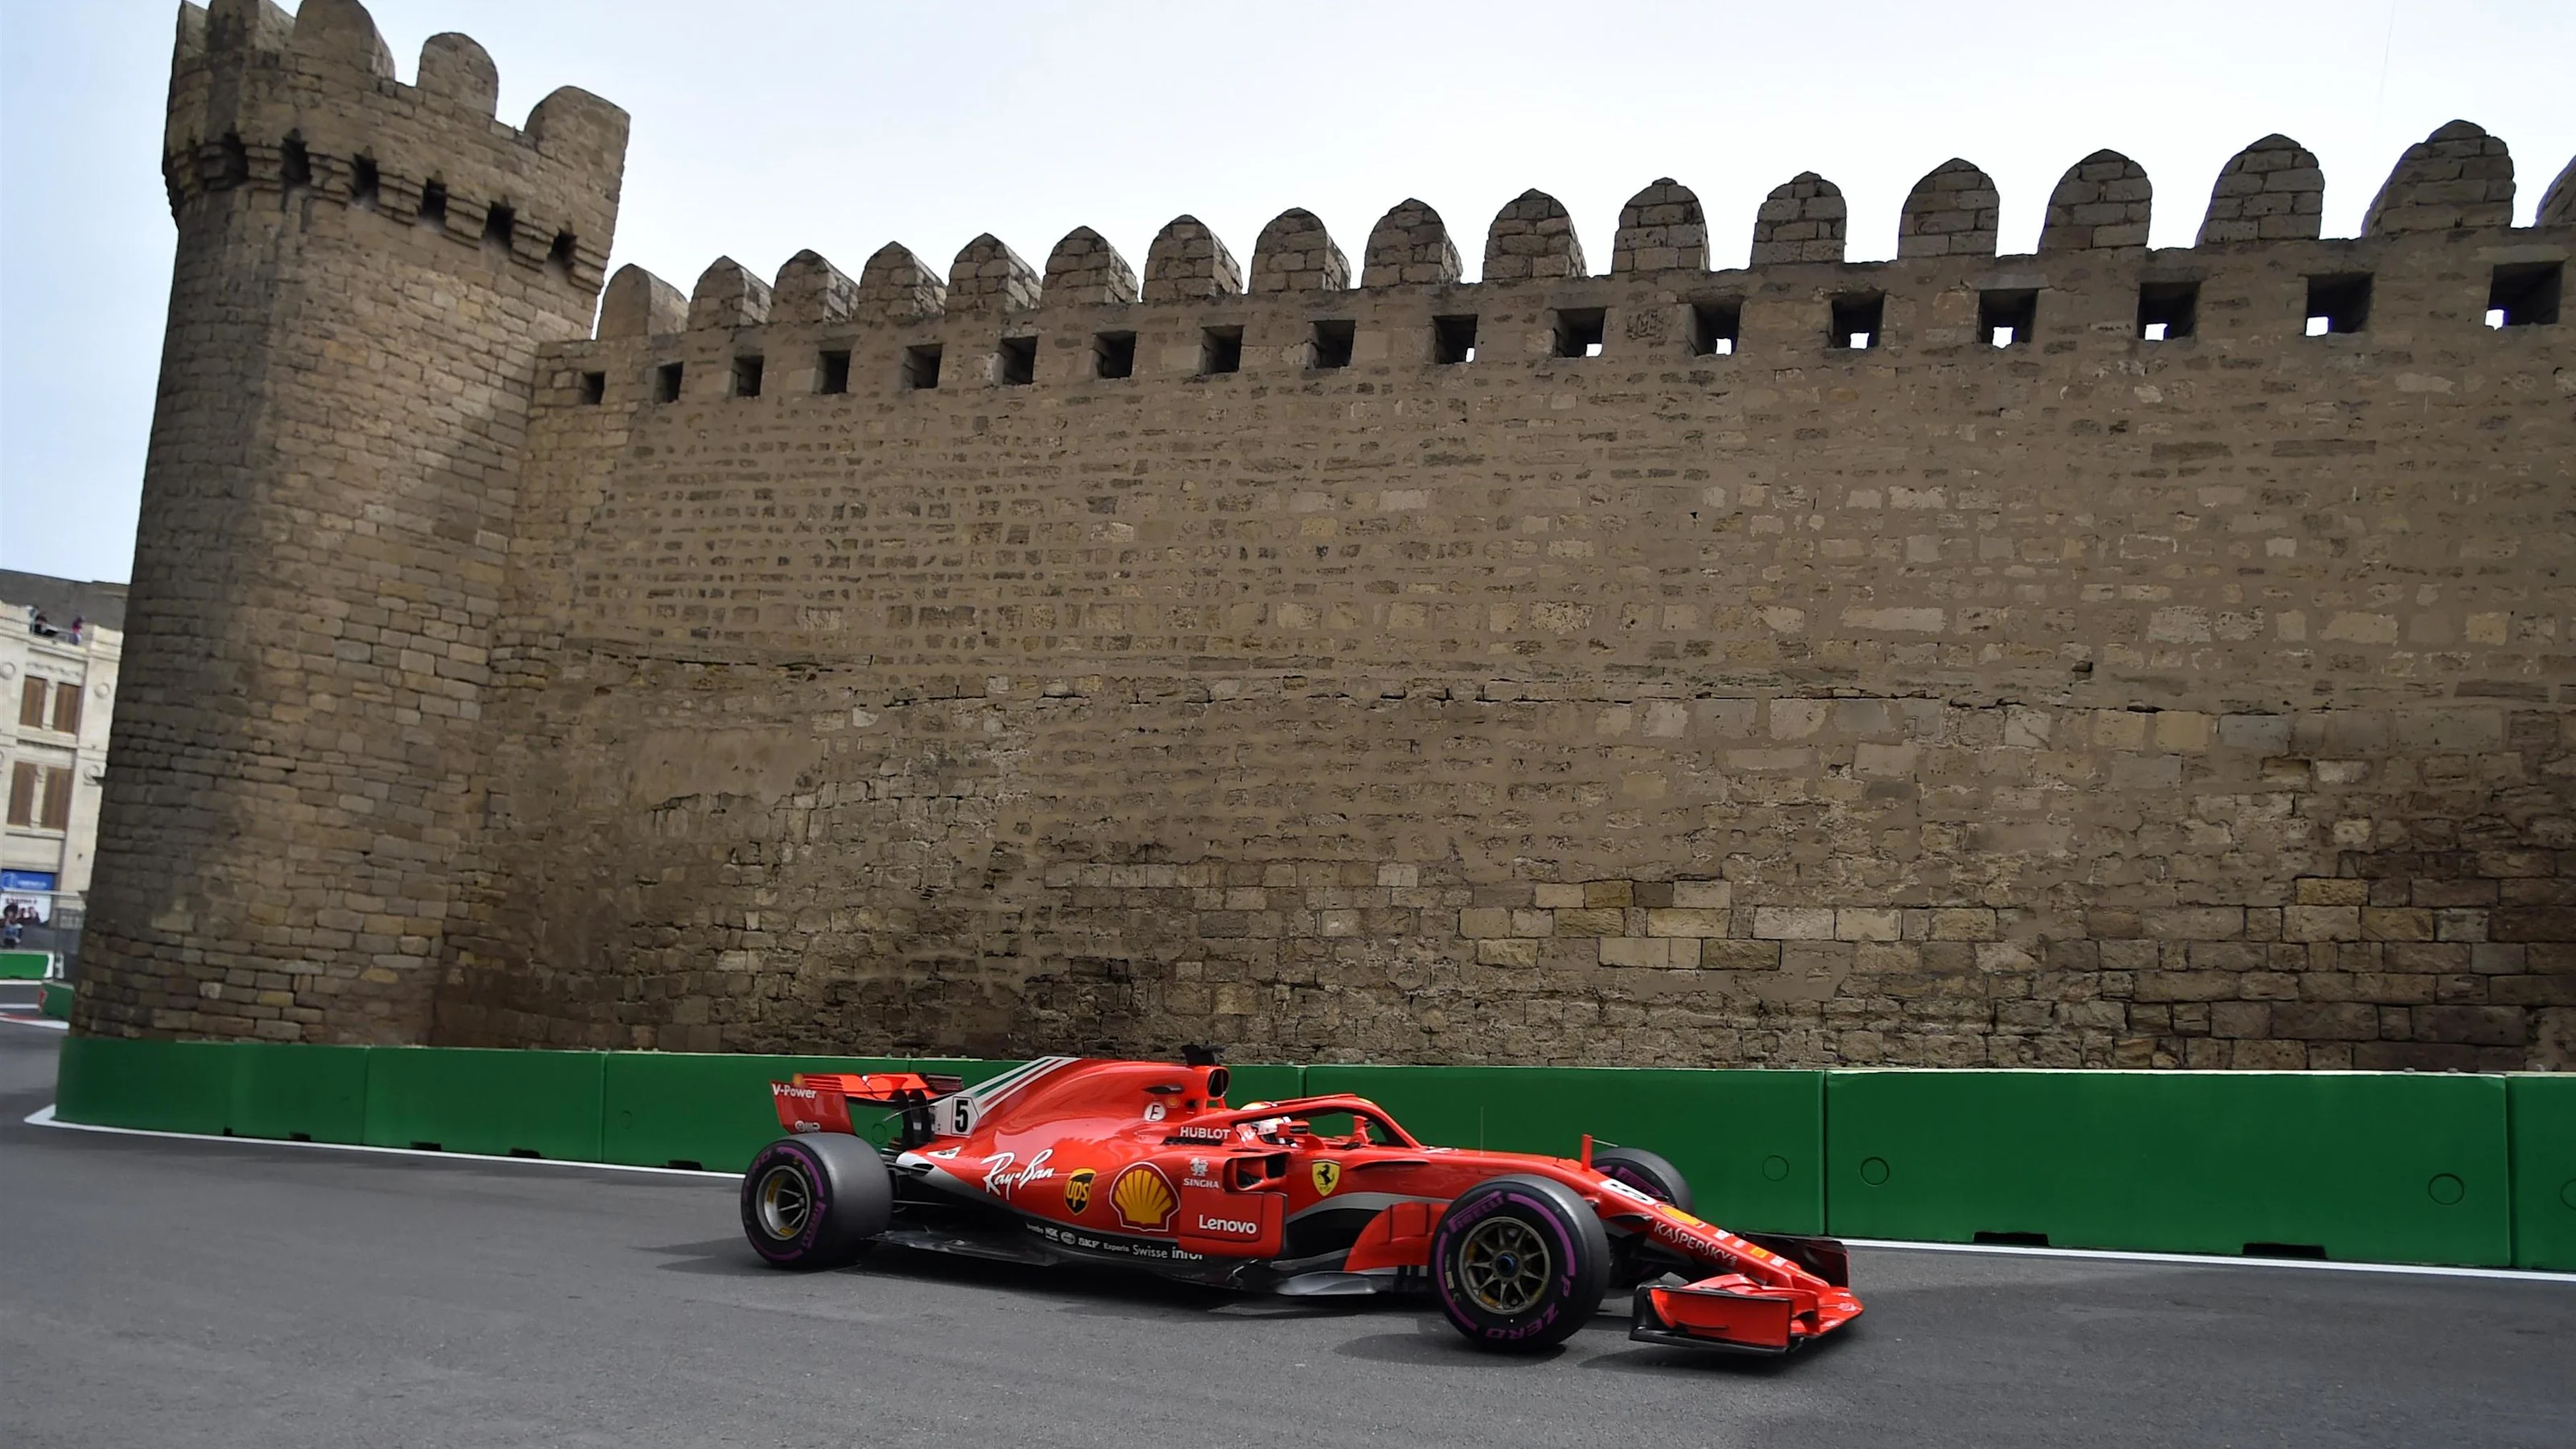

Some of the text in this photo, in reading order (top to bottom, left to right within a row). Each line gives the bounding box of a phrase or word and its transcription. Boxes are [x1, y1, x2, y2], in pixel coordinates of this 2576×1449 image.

[772, 1083, 817, 1099] V-Power
[955, 1100, 968, 1133] 5
[1150, 1104, 1160, 1121] E
[1180, 1126, 1231, 1140] HUBLOT
[1183, 1178, 1220, 1189] SINGHA
[1199, 1214, 1257, 1234] Lenovo
[1133, 1244, 1168, 1259] Swisse
[1486, 1274, 1571, 1340] P ZERO
